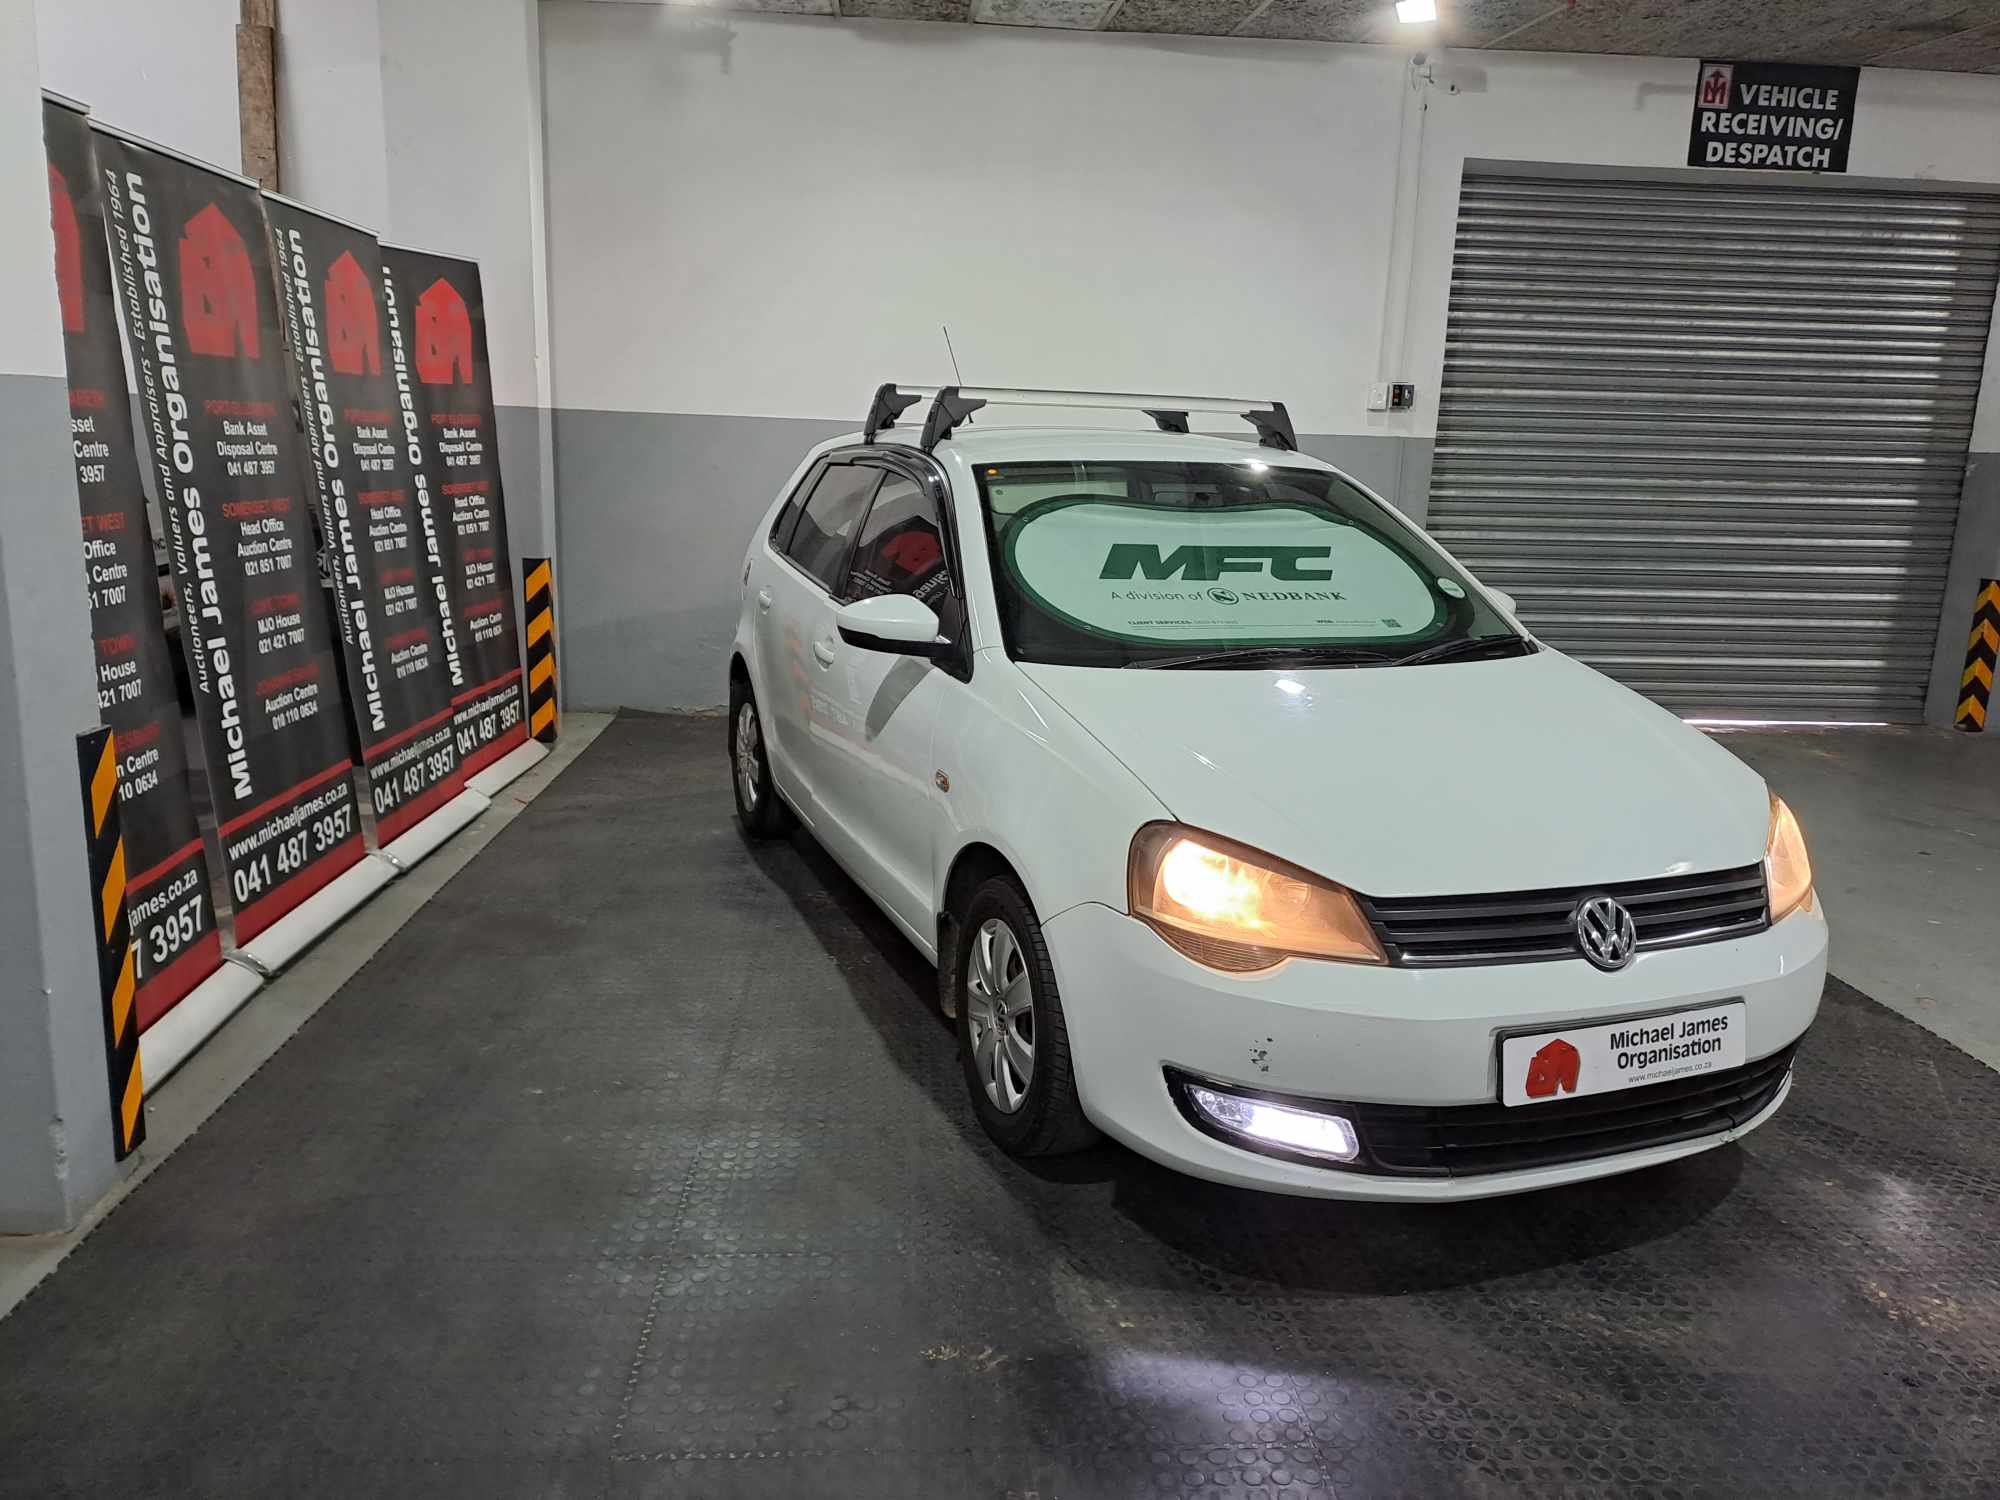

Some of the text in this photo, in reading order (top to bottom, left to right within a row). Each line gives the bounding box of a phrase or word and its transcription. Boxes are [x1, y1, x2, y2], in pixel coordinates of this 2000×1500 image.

[1739, 84, 1840, 111] VEHICLE
[1700, 111, 1845, 141] RECEIVING/
[1705, 141, 1831, 169] DESPATCH
[280, 270, 305, 364] Established
[70, 416, 95, 433] sset
[104, 167, 211, 694] Auctioneers, Valuers and Appraisers Established 1964
[222, 420, 246, 436] Bank
[300, 375, 323, 459] Appraisers
[73, 440, 110, 458] Centre
[216, 440, 255, 459] Disposal
[79, 465, 106, 483] 3957
[227, 461, 242, 477] 041
[288, 228, 387, 733] Michael James Organisation
[314, 458, 326, 491] and
[125, 172, 253, 800] Michael James Organisation
[240, 517, 285, 537] Head Office
[321, 494, 337, 550] Valuers
[414, 474, 442, 568] James
[83, 539, 117, 560] Office
[237, 537, 293, 558] Auction Centre
[1099, 542, 1334, 582] MFC
[92, 562, 128, 584] Centre
[101, 585, 126, 606] 7007
[1111, 590, 1348, 601] A division of NEDBANK
[275, 613, 301, 629] House
[431, 575, 464, 687] Michael
[272, 634, 287, 650] 421
[100, 660, 137, 683] House
[118, 678, 142, 702] 7007
[264, 683, 319, 714] Auction Centre
[456, 700, 520, 755] 041 487 3957
[126, 748, 160, 775] Centre
[369, 726, 452, 780] www.michaeljames.co.za
[119, 778, 134, 802] 10
[135, 768, 159, 796] 0634
[374, 744, 454, 815] 041 487 3957
[228, 782, 349, 861] www.michaeljames.co.za
[233, 803, 351, 903] 041 487 3957
[127, 869, 199, 937] james.co.za
[149, 893, 202, 963] 3957
[1609, 1015, 1729, 1050] Michael James
[1616, 1036, 1722, 1070] Organisation
